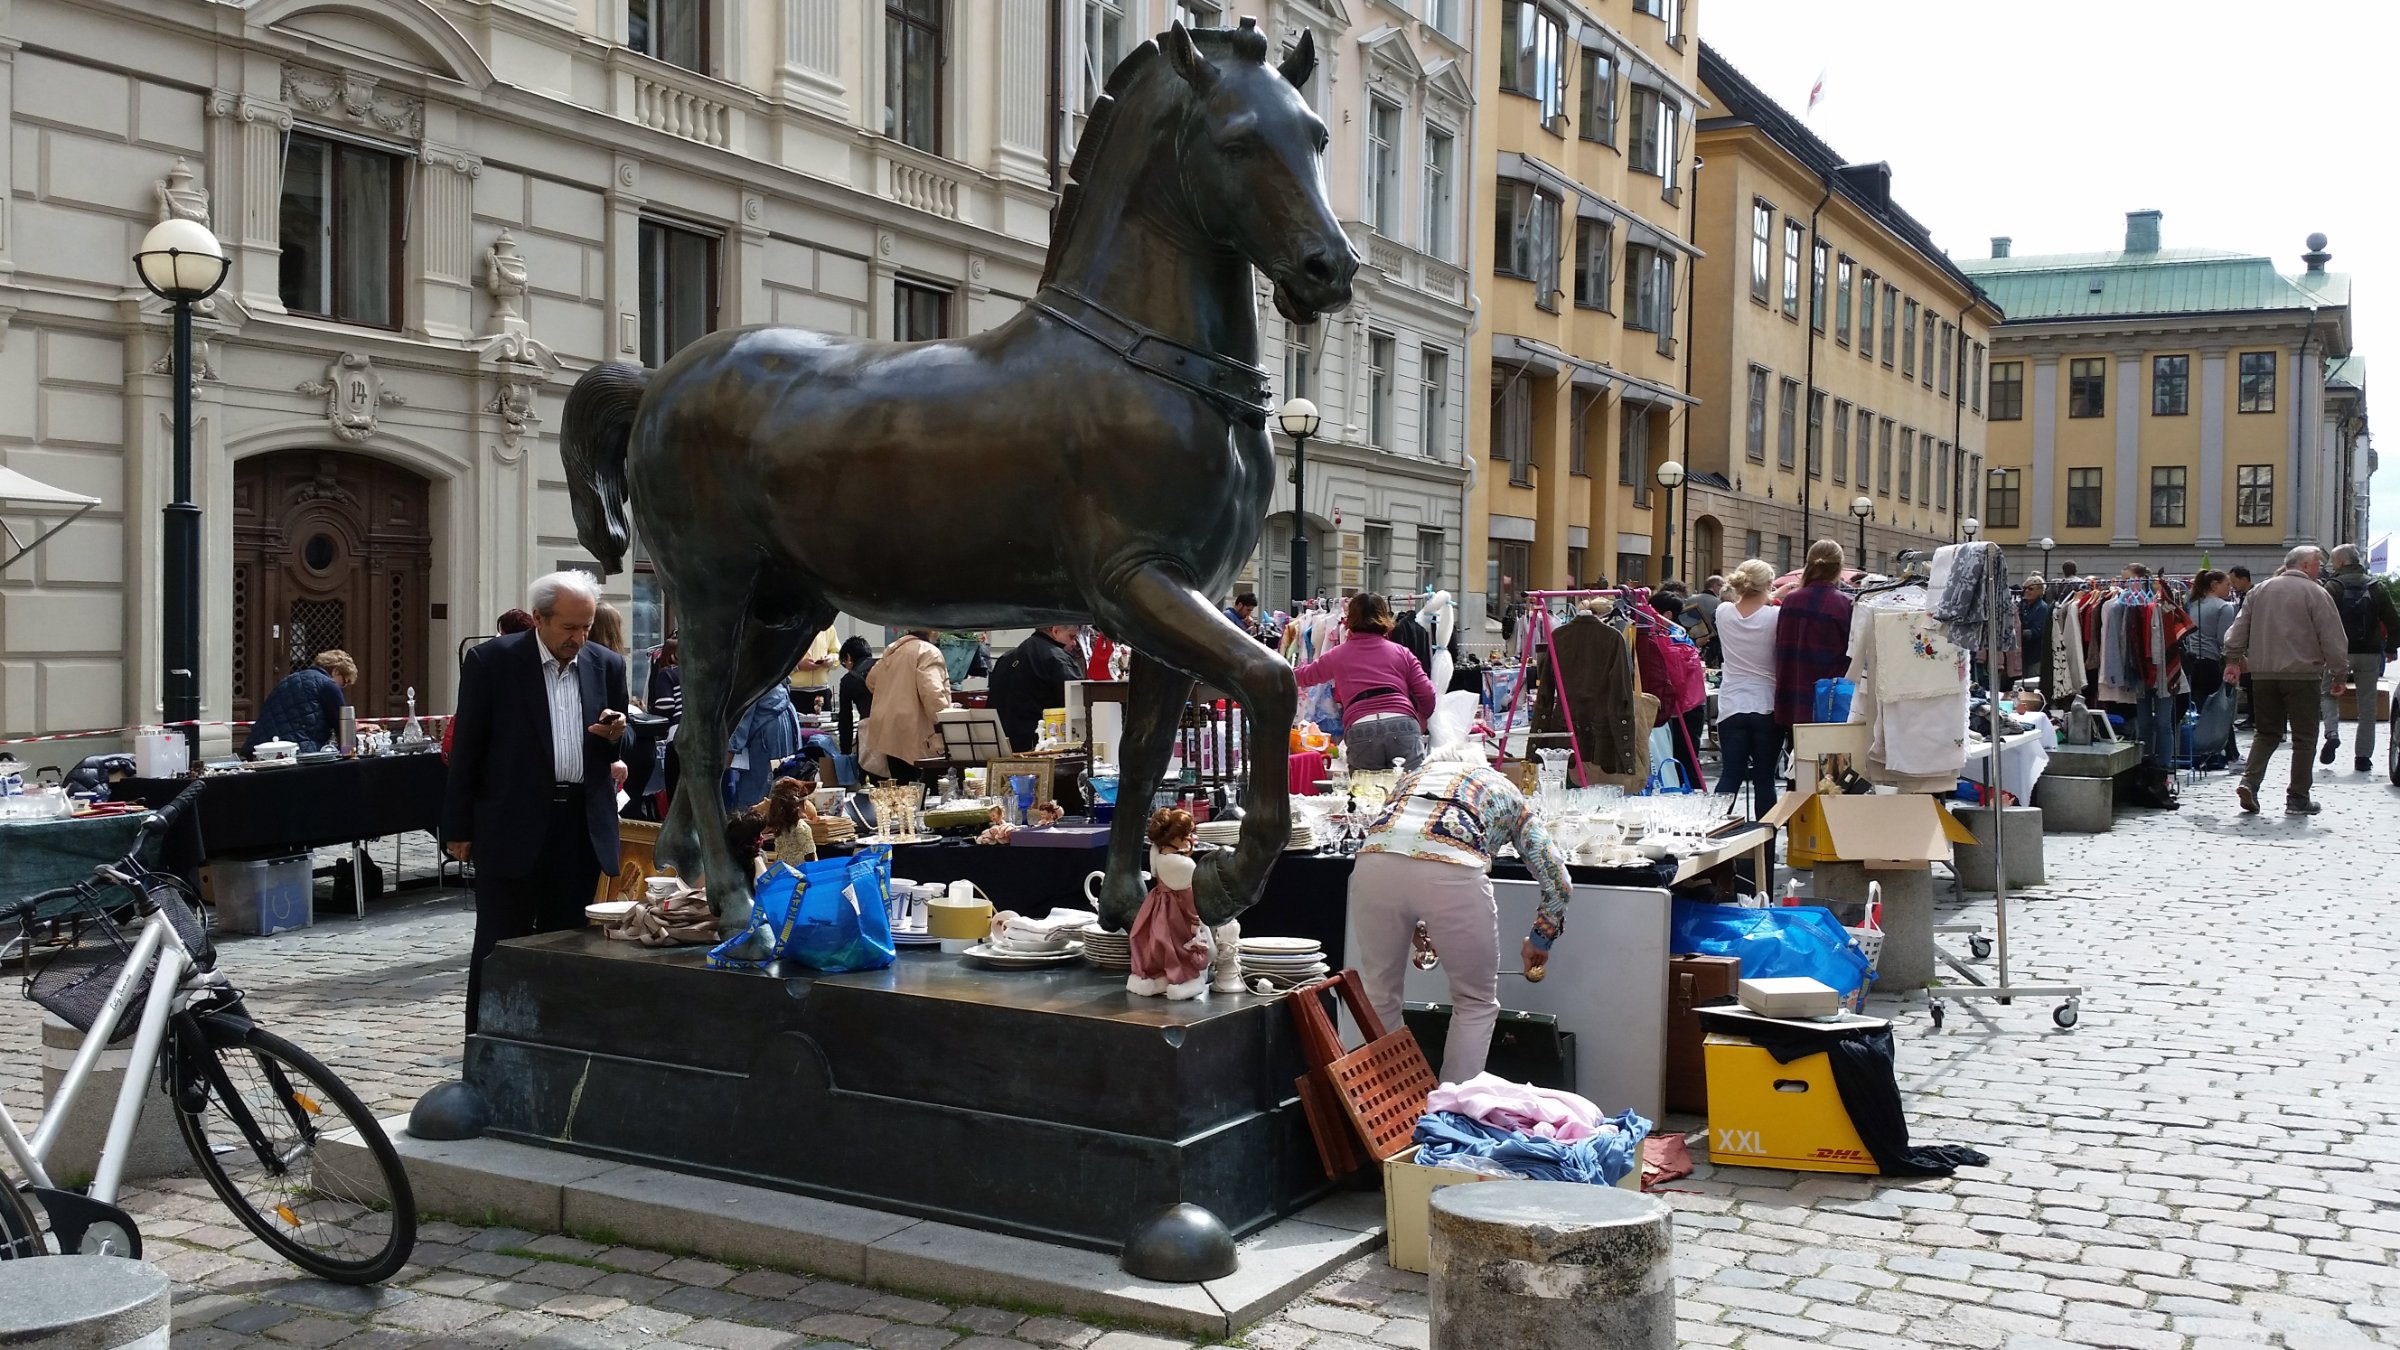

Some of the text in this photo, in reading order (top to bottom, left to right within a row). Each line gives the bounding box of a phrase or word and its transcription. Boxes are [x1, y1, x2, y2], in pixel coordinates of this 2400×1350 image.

[351, 381, 368, 405] 14
[1718, 1129, 1767, 1154] XXL
[1816, 1148, 1863, 1160] DHL
